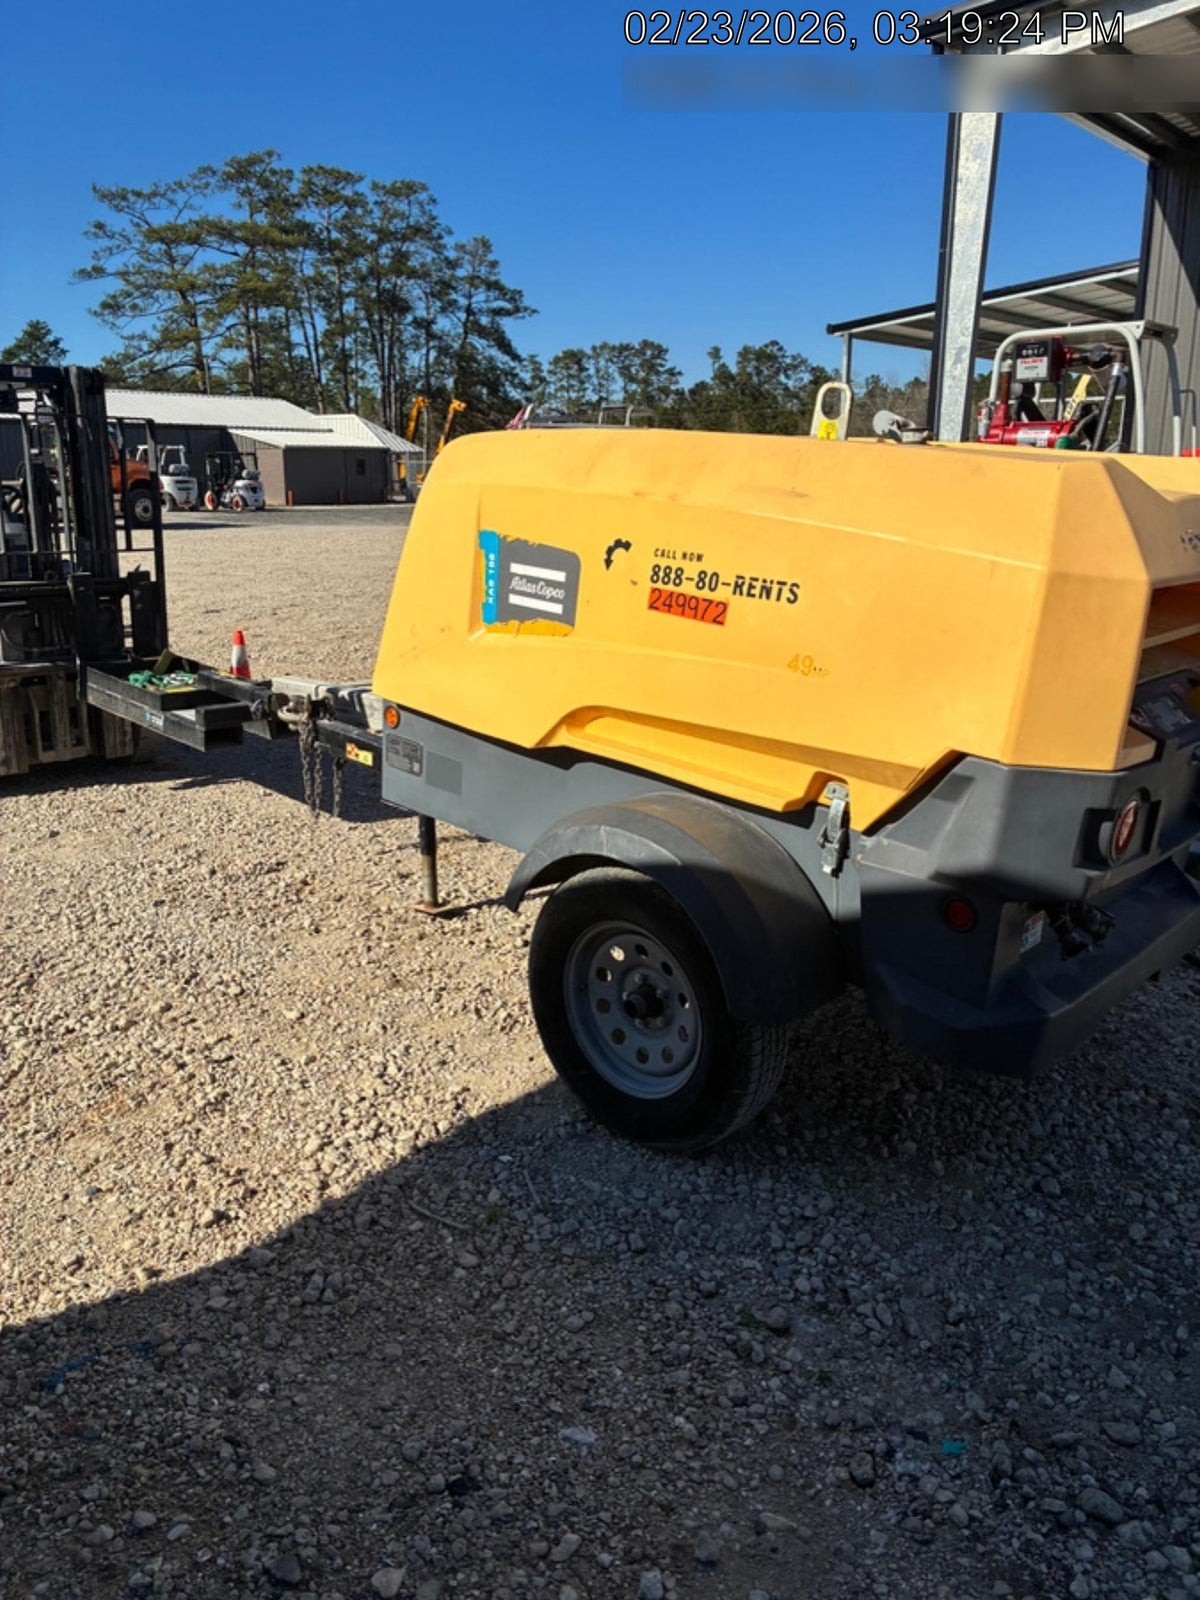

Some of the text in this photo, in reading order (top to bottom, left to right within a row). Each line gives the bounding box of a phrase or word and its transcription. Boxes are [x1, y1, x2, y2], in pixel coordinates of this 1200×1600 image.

[654, 547, 704, 562] CALL NOW
[509, 576, 566, 600] Atlas Copco
[650, 563, 801, 604] 888-80-RENTS
[649, 587, 728, 626] 249972
